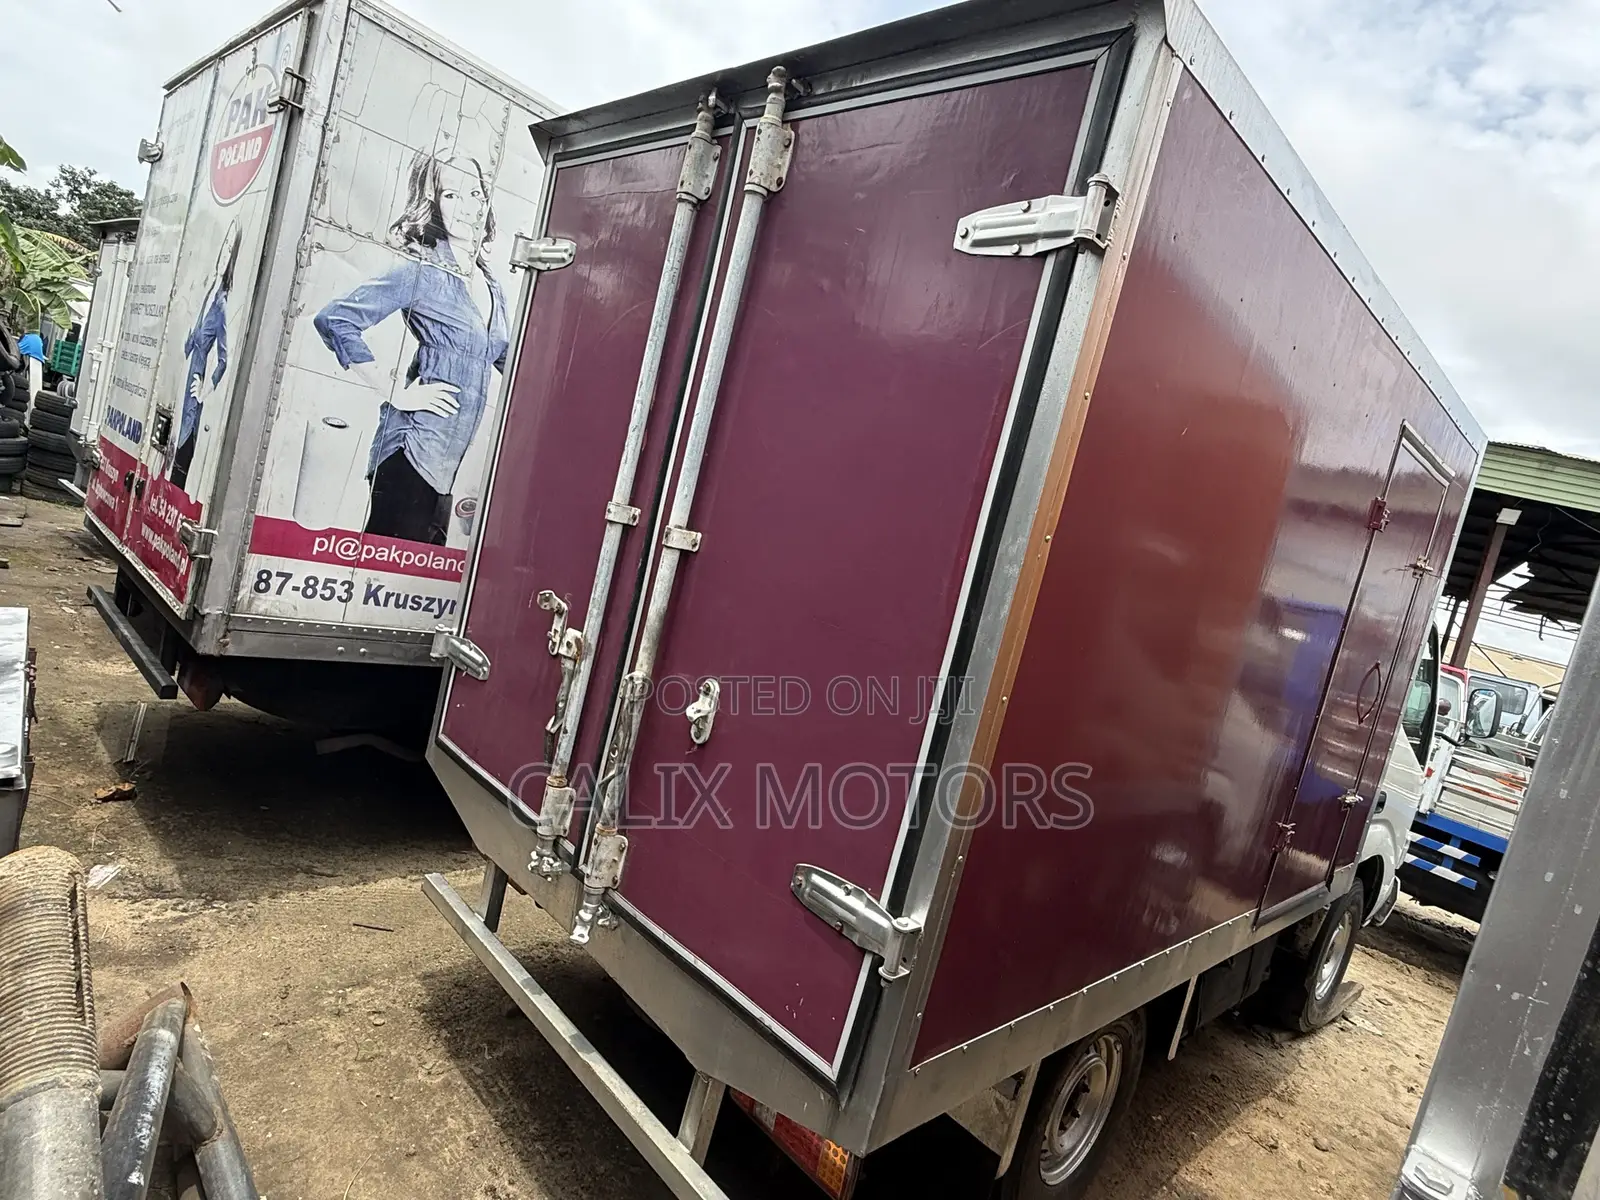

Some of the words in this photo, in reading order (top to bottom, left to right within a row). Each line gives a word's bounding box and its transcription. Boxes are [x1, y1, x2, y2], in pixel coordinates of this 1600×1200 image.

[224, 81, 274, 138] PAK
[217, 136, 263, 170] POLAND
[253, 568, 354, 604] 87-853
